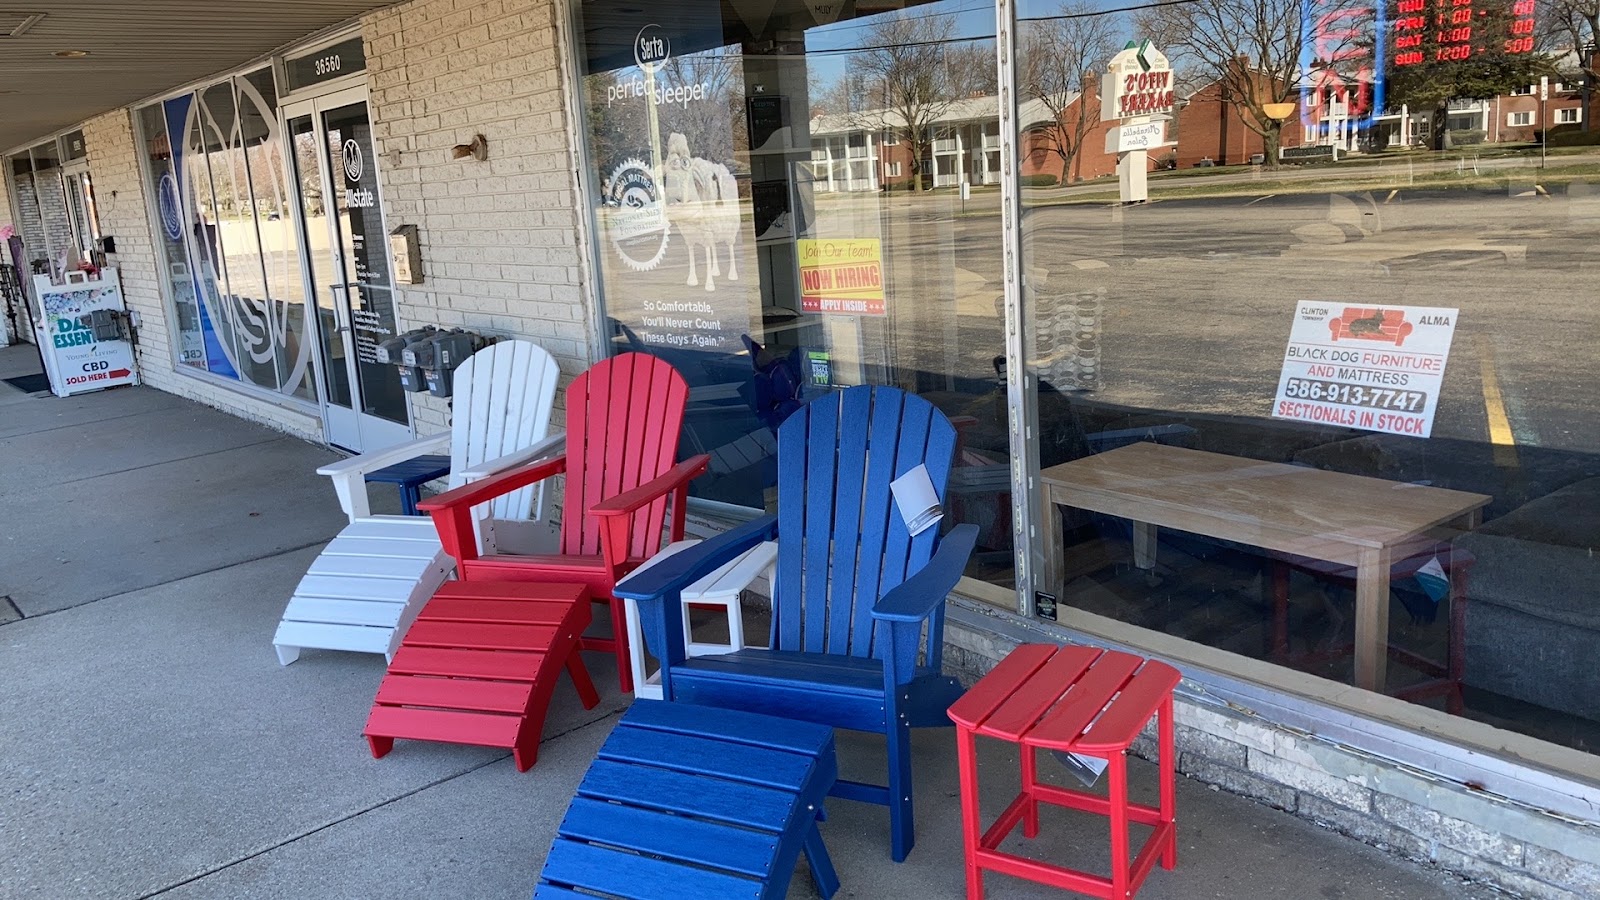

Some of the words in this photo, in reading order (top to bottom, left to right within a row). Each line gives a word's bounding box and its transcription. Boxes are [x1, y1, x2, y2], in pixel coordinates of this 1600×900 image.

[640, 36, 664, 60] Serta
[1395, 34, 1423, 48] SAT
[315, 55, 341, 75] 36560
[1395, 51, 1424, 66] SUN
[608, 75, 656, 108] perfect
[653, 81, 709, 109] sleeper
[345, 188, 374, 208] Allstate
[803, 242, 821, 259] Join
[824, 243, 843, 257] Our
[847, 243, 873, 258] Team!
[803, 269, 833, 291] NOW
[834, 265, 880, 289] HIRING
[643, 300, 655, 311] So
[656, 300, 714, 315] Comfortable,
[820, 299, 841, 311] APPLY
[842, 300, 868, 312] INSIDE
[641, 315, 664, 327] You'll
[665, 317, 693, 328] Never
[695, 318, 721, 331] Count
[1301, 307, 1329, 316] CLINTON
[1419, 315, 1450, 326] ALMA
[640, 331, 665, 343] These
[666, 333, 689, 346] Guys
[82, 360, 109, 372] CBD
[1287, 346, 1328, 360] BLACK
[1331, 350, 1359, 363] DOG
[1362, 353, 1442, 371] FURNITURE
[66, 376, 87, 385] SOLD
[88, 372, 108, 382] HERE
[1307, 365, 1335, 378] AND
[1338, 368, 1409, 386] MATTRESS
[1286, 379, 1422, 411] 586-913-7747
[1278, 400, 1356, 425] SECTIONALS
[1359, 411, 1374, 428] IN
[1377, 413, 1425, 435] STOCK
